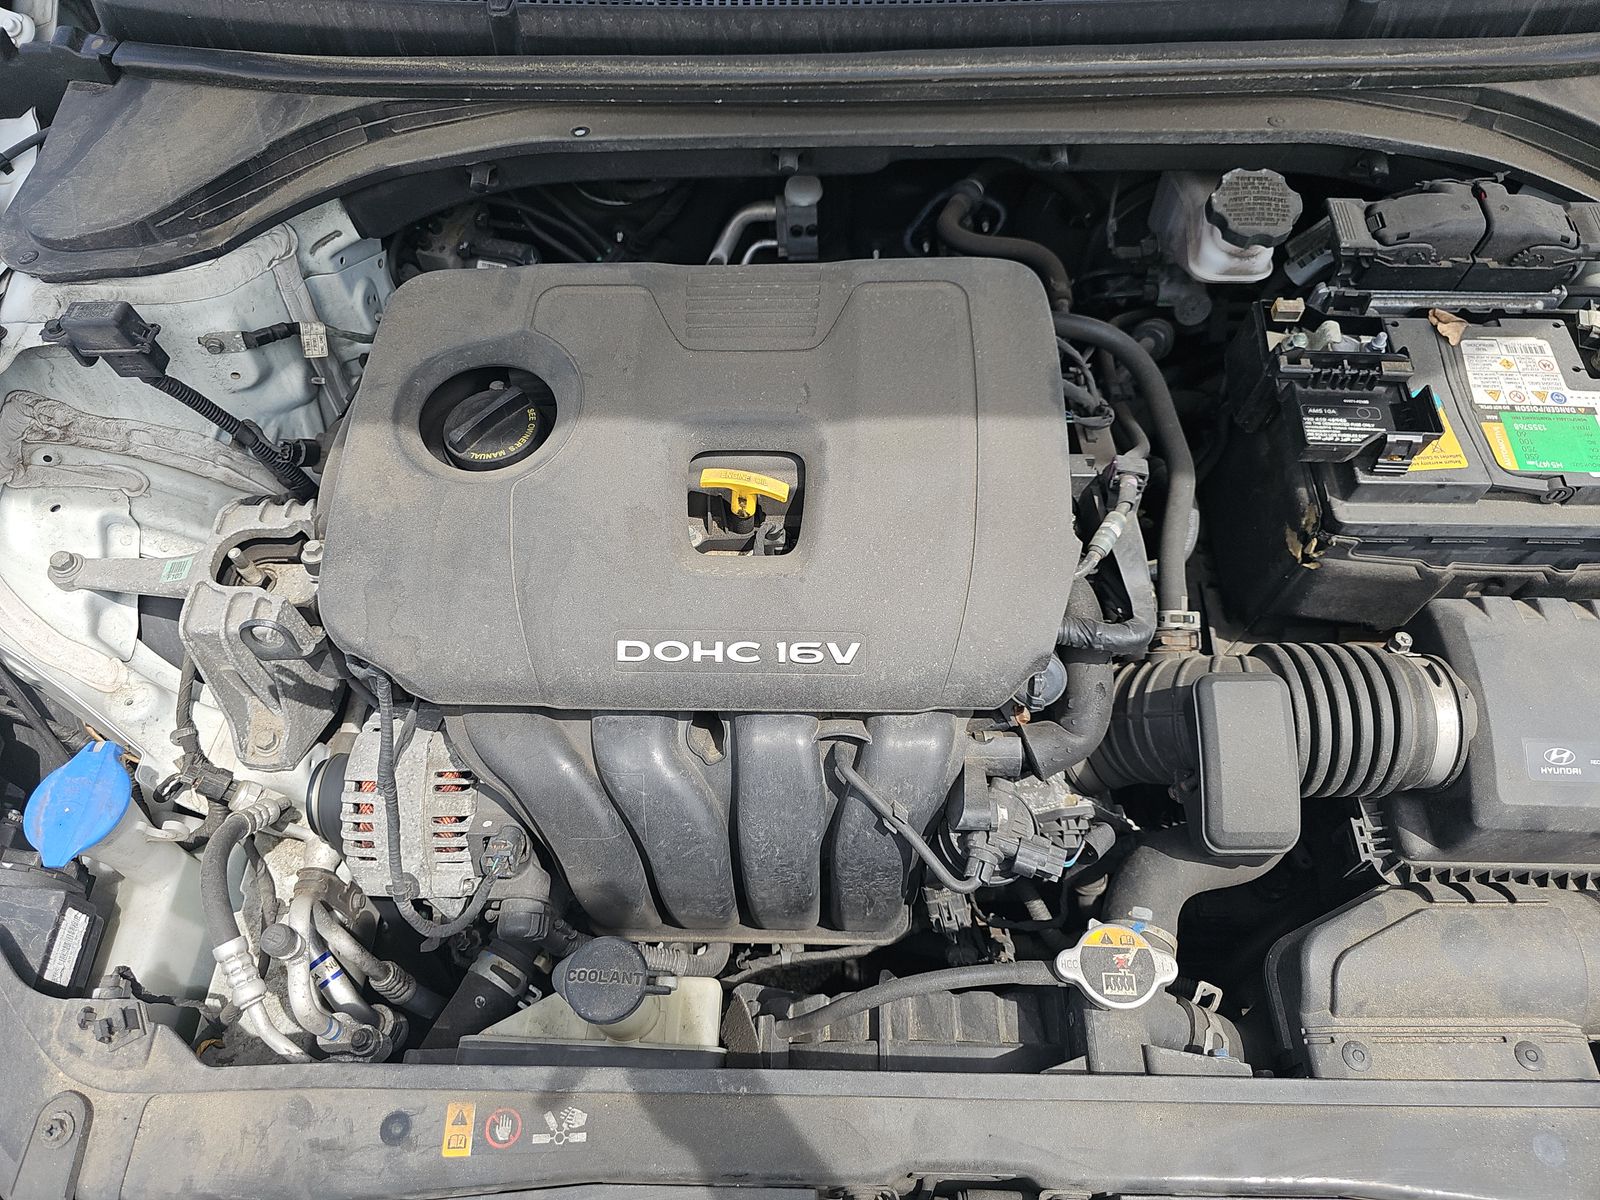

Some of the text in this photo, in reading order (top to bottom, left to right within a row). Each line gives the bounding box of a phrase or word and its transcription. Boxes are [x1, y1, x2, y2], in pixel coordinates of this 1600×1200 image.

[1514, 405, 1576, 415] DANGER/POISON
[1513, 423, 1547, 431] 1355768
[470, 407, 537, 460] SEE OWNER'S MANUAL
[720, 471, 768, 486] ENGINE OIL
[616, 639, 862, 665] DOHC 16V
[1540, 766, 1582, 775] HYUNDAI
[1060, 959, 1078, 969] HCC
[567, 969, 644, 985] COOLANT
